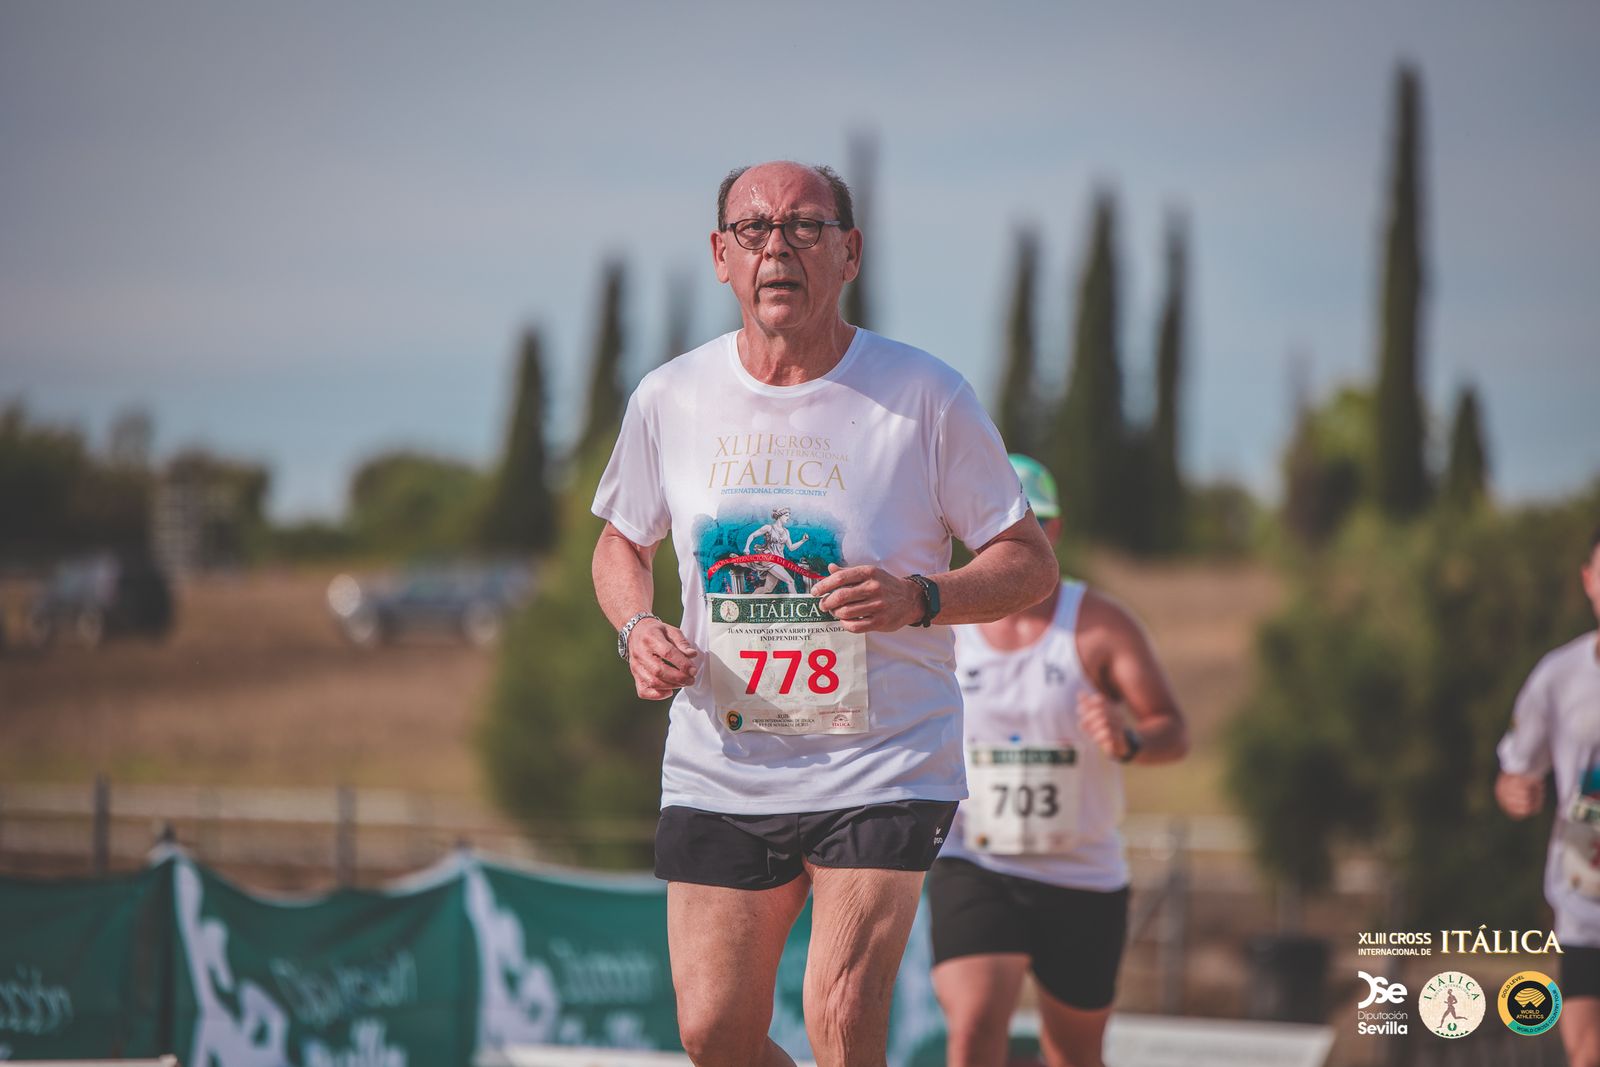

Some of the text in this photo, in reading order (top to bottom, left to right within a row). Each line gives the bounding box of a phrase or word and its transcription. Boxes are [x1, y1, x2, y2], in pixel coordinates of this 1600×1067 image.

[715, 433, 831, 458] XLIII CROSS
[774, 449, 849, 462] INTERNACIONAL
[708, 454, 847, 490] ITÁLICA
[720, 487, 772, 495] INTERNATIONAL
[794, 489, 828, 497] COUNTRY
[749, 600, 821, 618] ITÁLICA
[739, 648, 840, 695] 778
[990, 784, 1060, 818] 703
